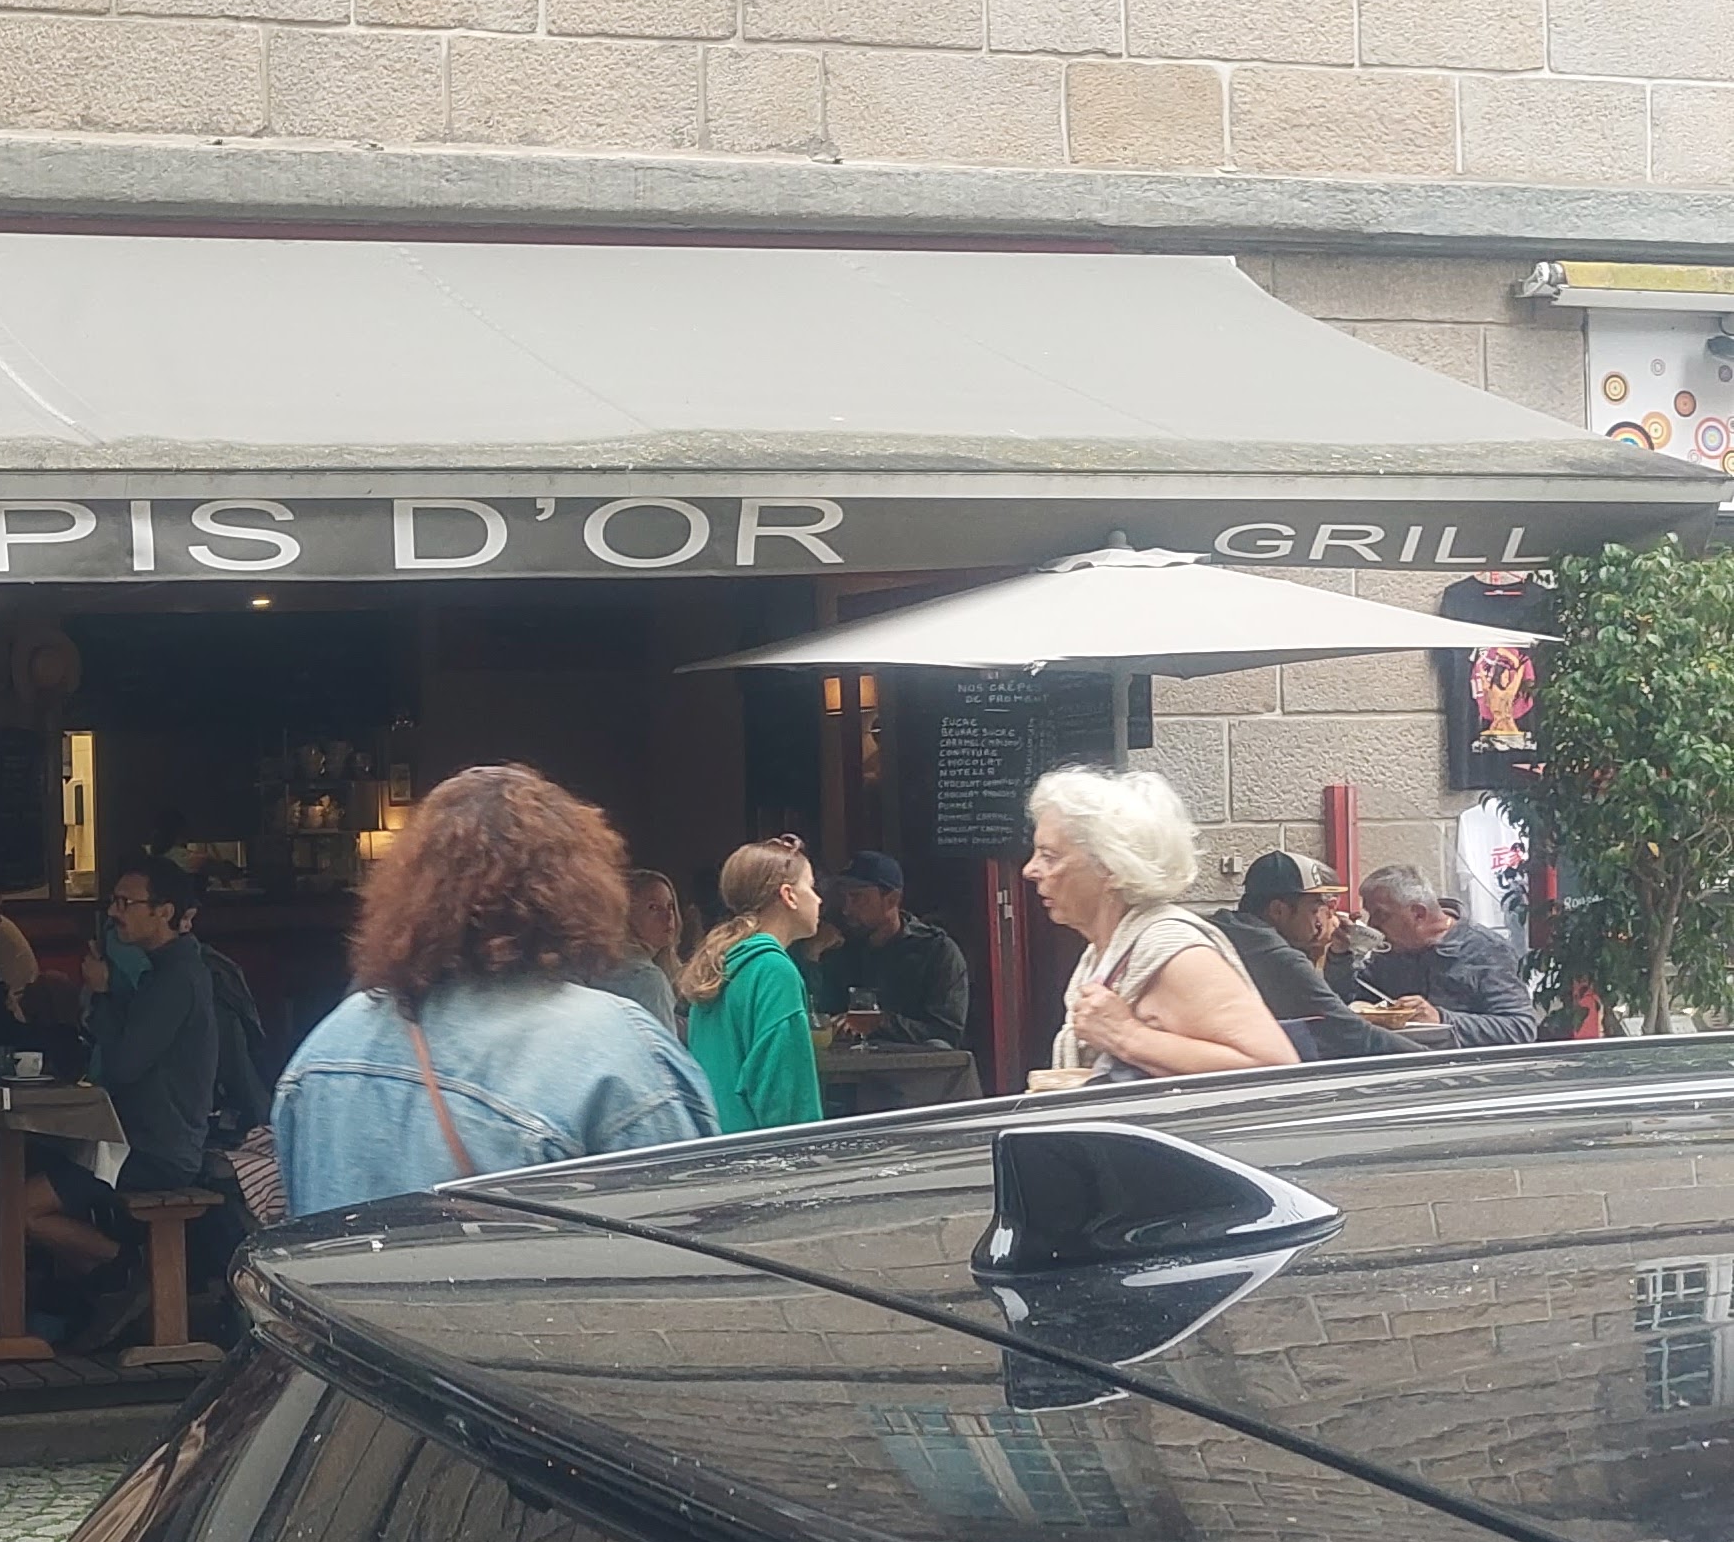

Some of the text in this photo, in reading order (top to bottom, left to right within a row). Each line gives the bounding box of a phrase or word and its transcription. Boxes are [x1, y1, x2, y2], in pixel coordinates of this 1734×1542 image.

[392, 497, 846, 570] D'OR
[1214, 522, 1550, 564] GRILL
[957, 683, 984, 693] NOS
[965, 695, 982, 704] DE
[937, 758, 1004, 767] CHOCOLAT
